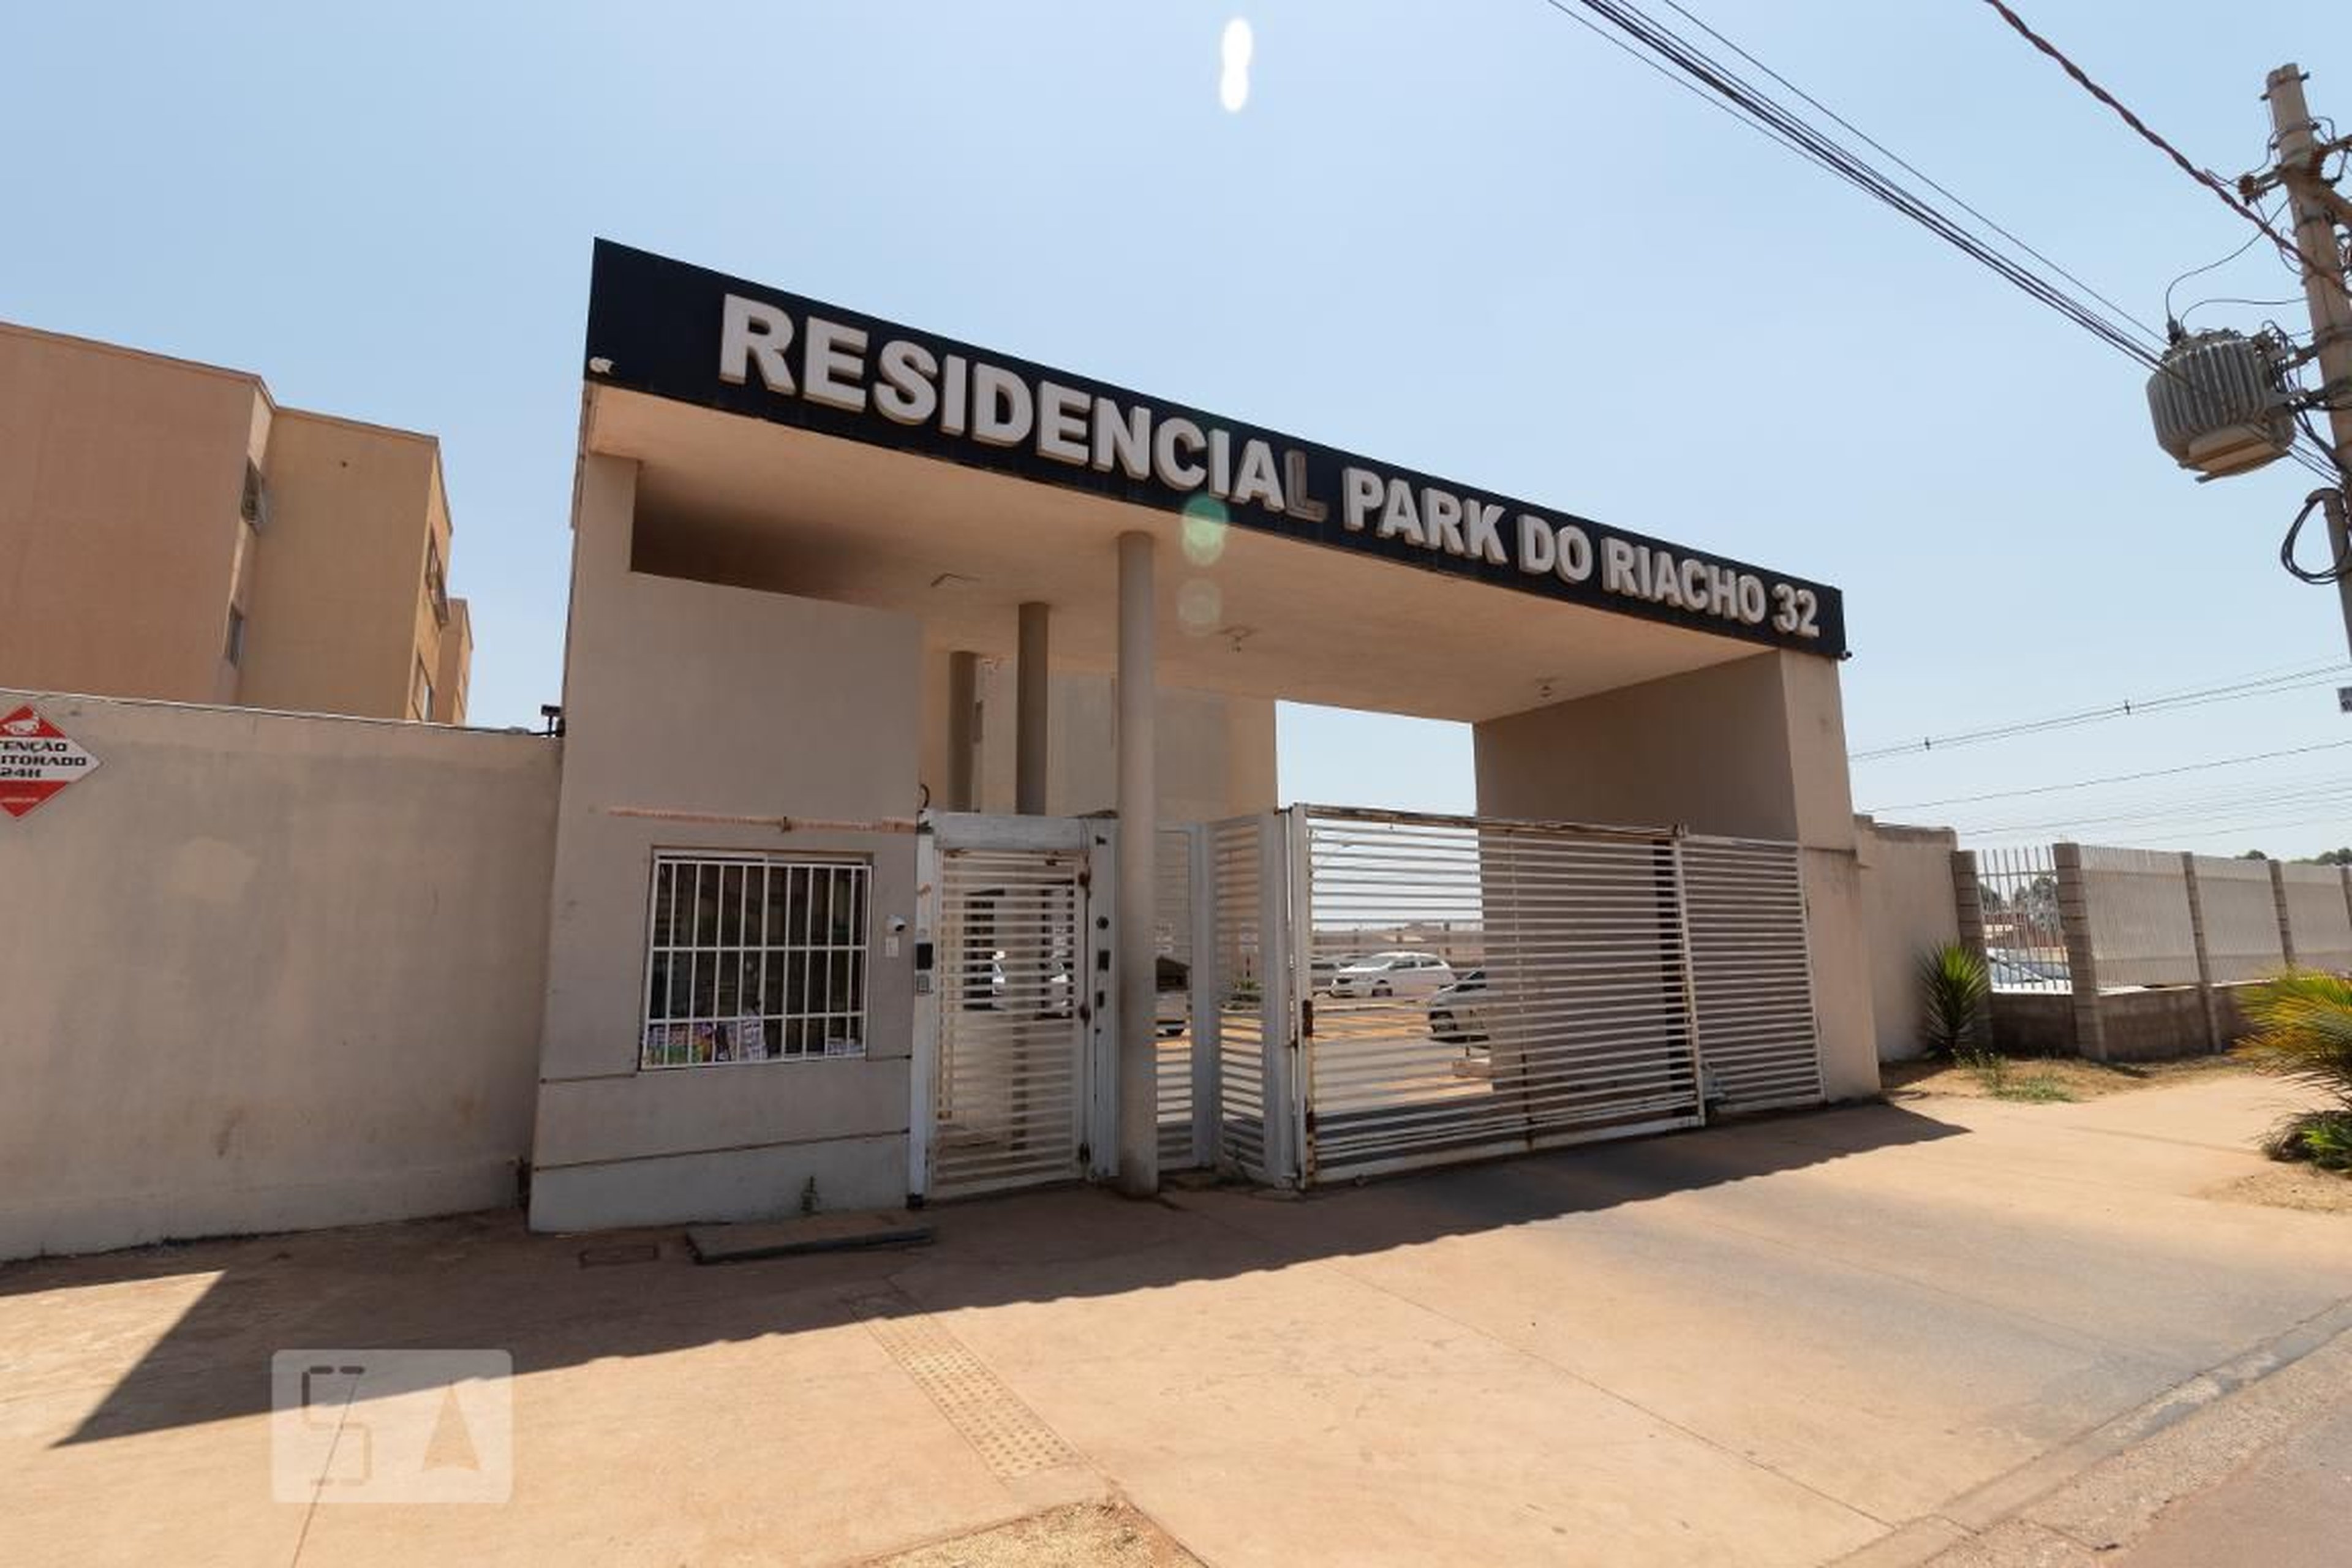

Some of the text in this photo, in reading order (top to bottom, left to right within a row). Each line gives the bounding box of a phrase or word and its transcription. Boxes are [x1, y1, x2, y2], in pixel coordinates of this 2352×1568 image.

[719, 293, 1820, 638] RESIDENCIAL PARK DO RIACHO 32
